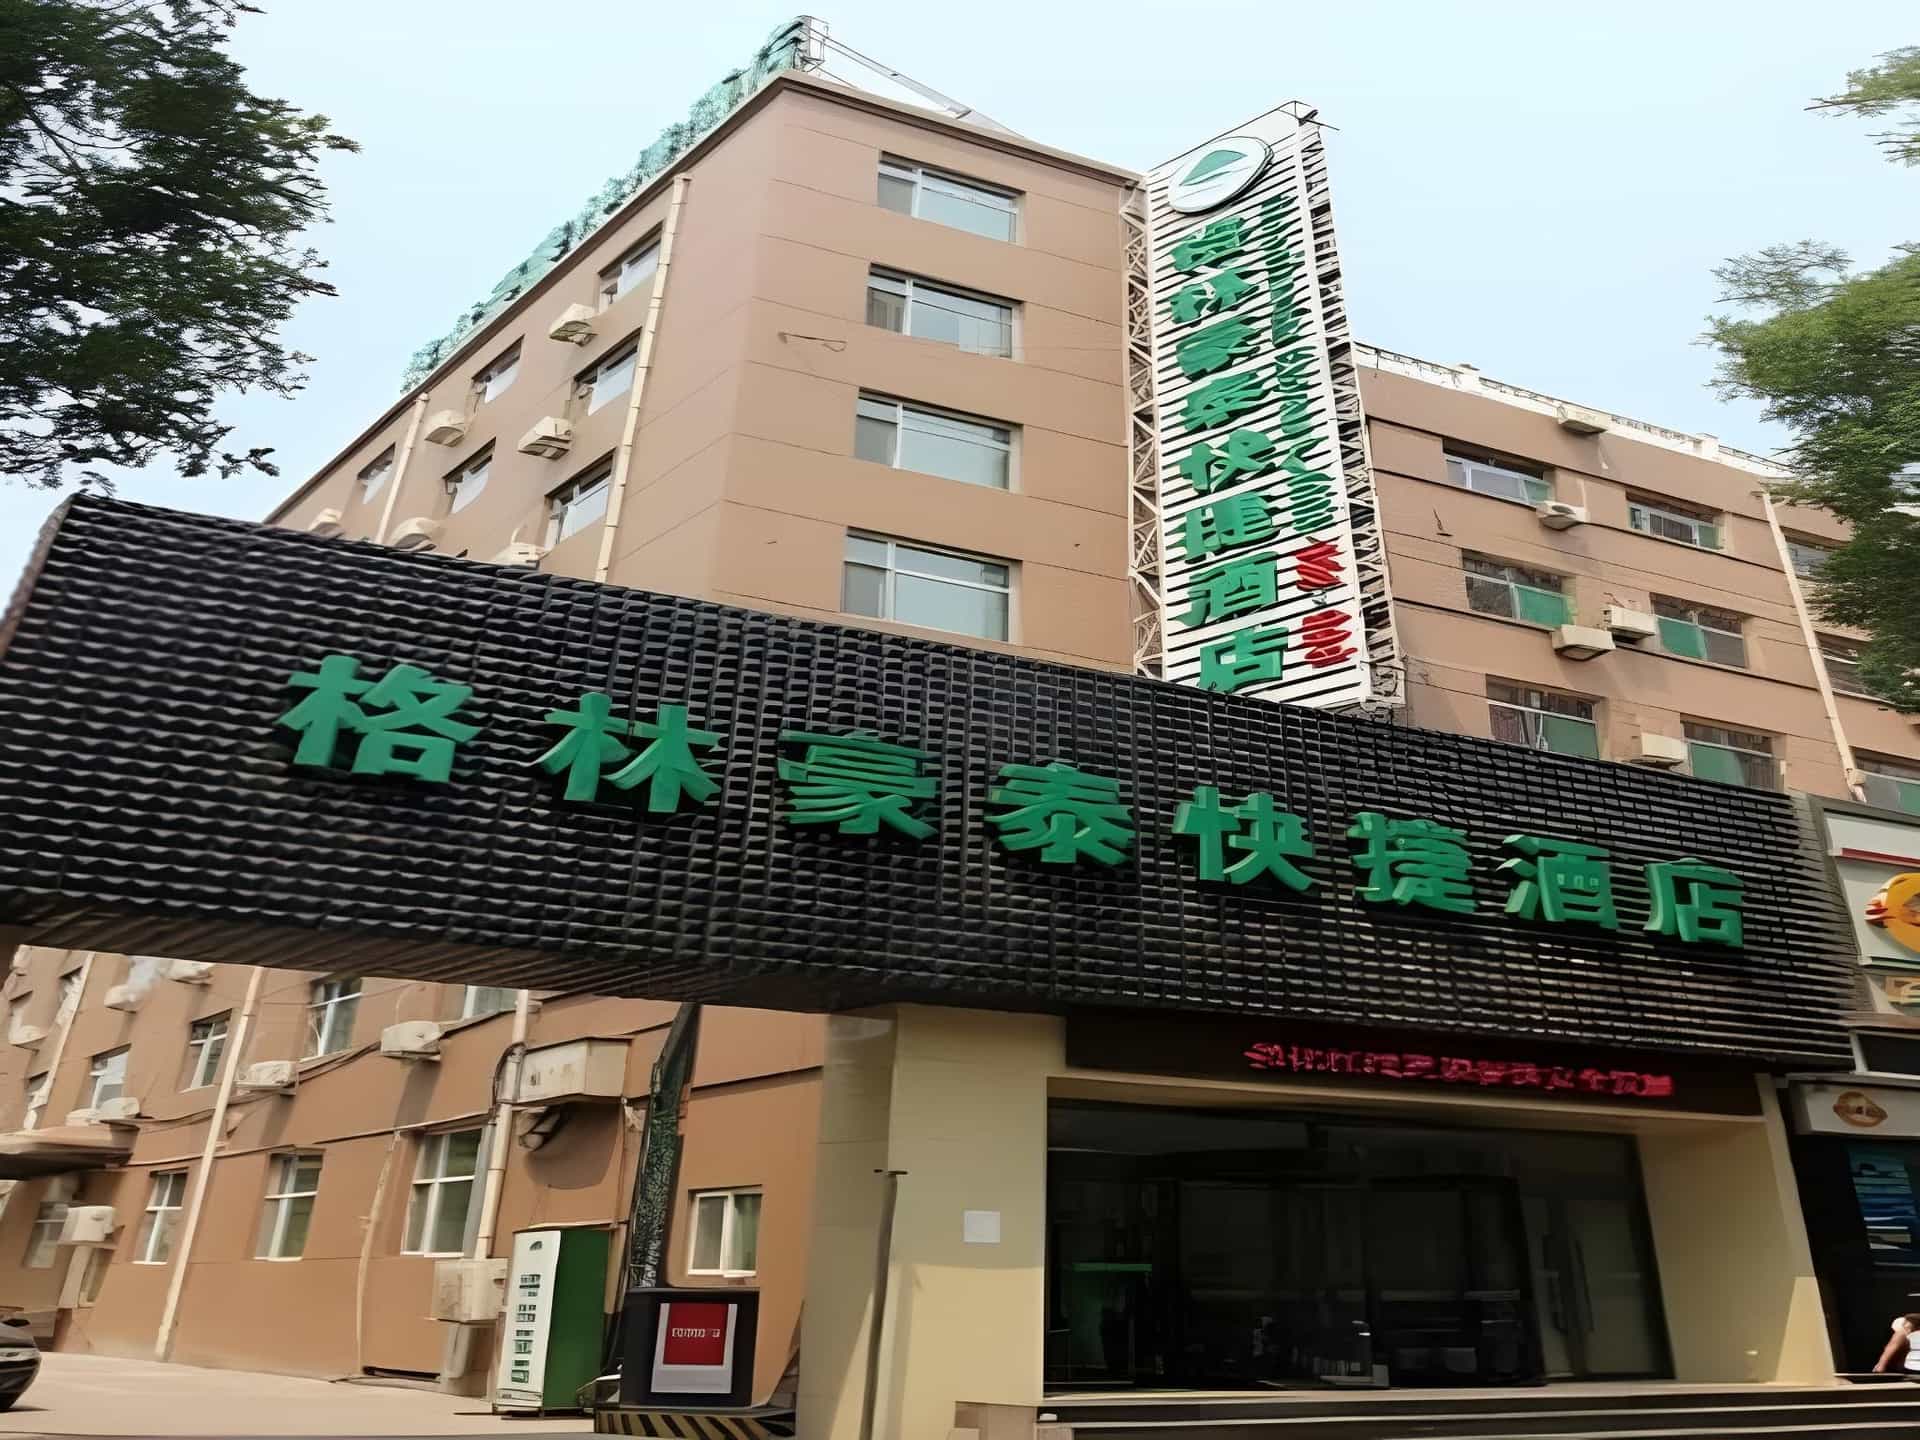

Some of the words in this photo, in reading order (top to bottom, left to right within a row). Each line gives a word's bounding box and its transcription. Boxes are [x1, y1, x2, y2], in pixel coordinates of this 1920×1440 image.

[276, 654, 1744, 948] 格林豪泰快捷酒店
